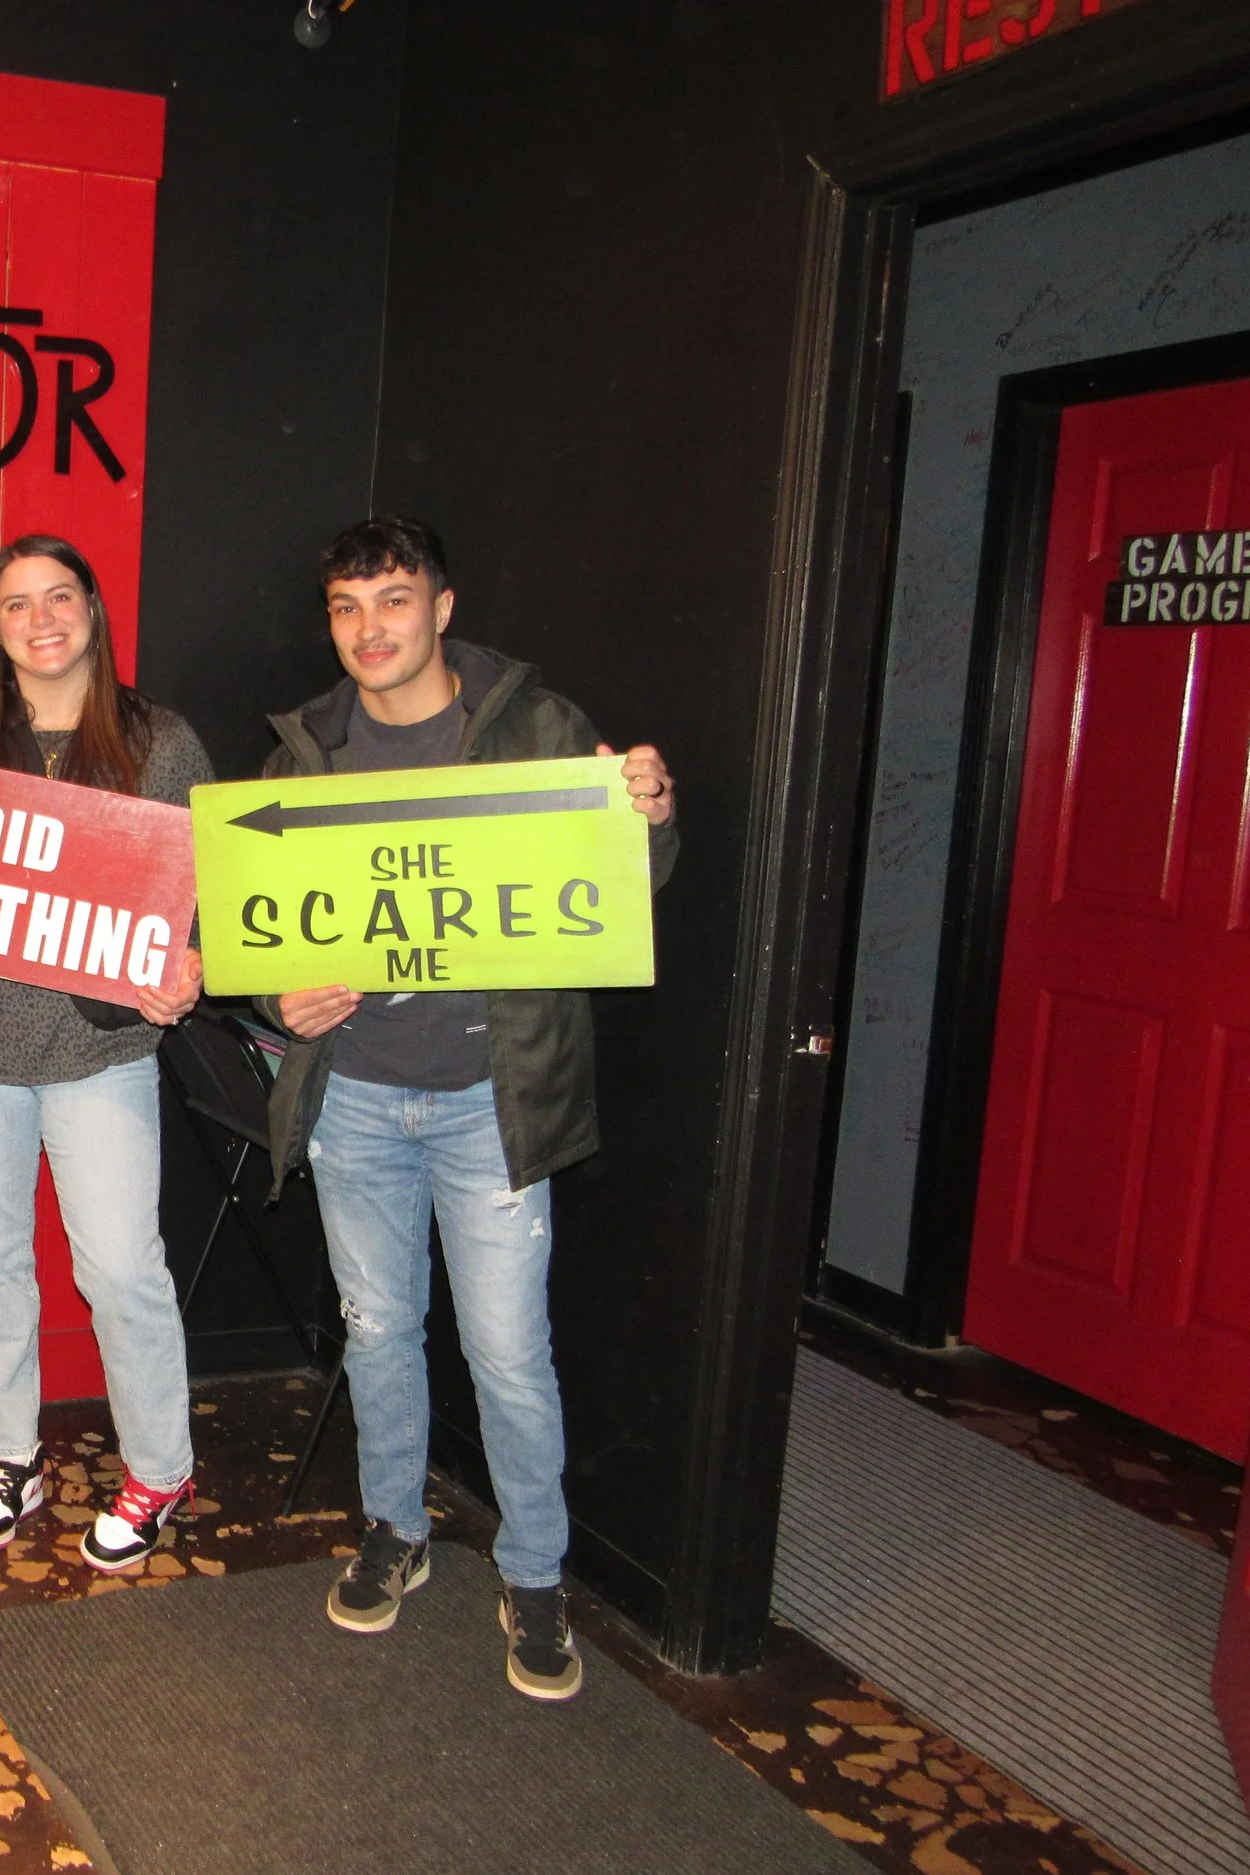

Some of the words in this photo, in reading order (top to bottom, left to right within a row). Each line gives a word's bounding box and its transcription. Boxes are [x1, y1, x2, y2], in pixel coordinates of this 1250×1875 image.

[371, 843, 455, 882] SHE
[241, 878, 605, 949] SCARES
[386, 948, 451, 983] ME
